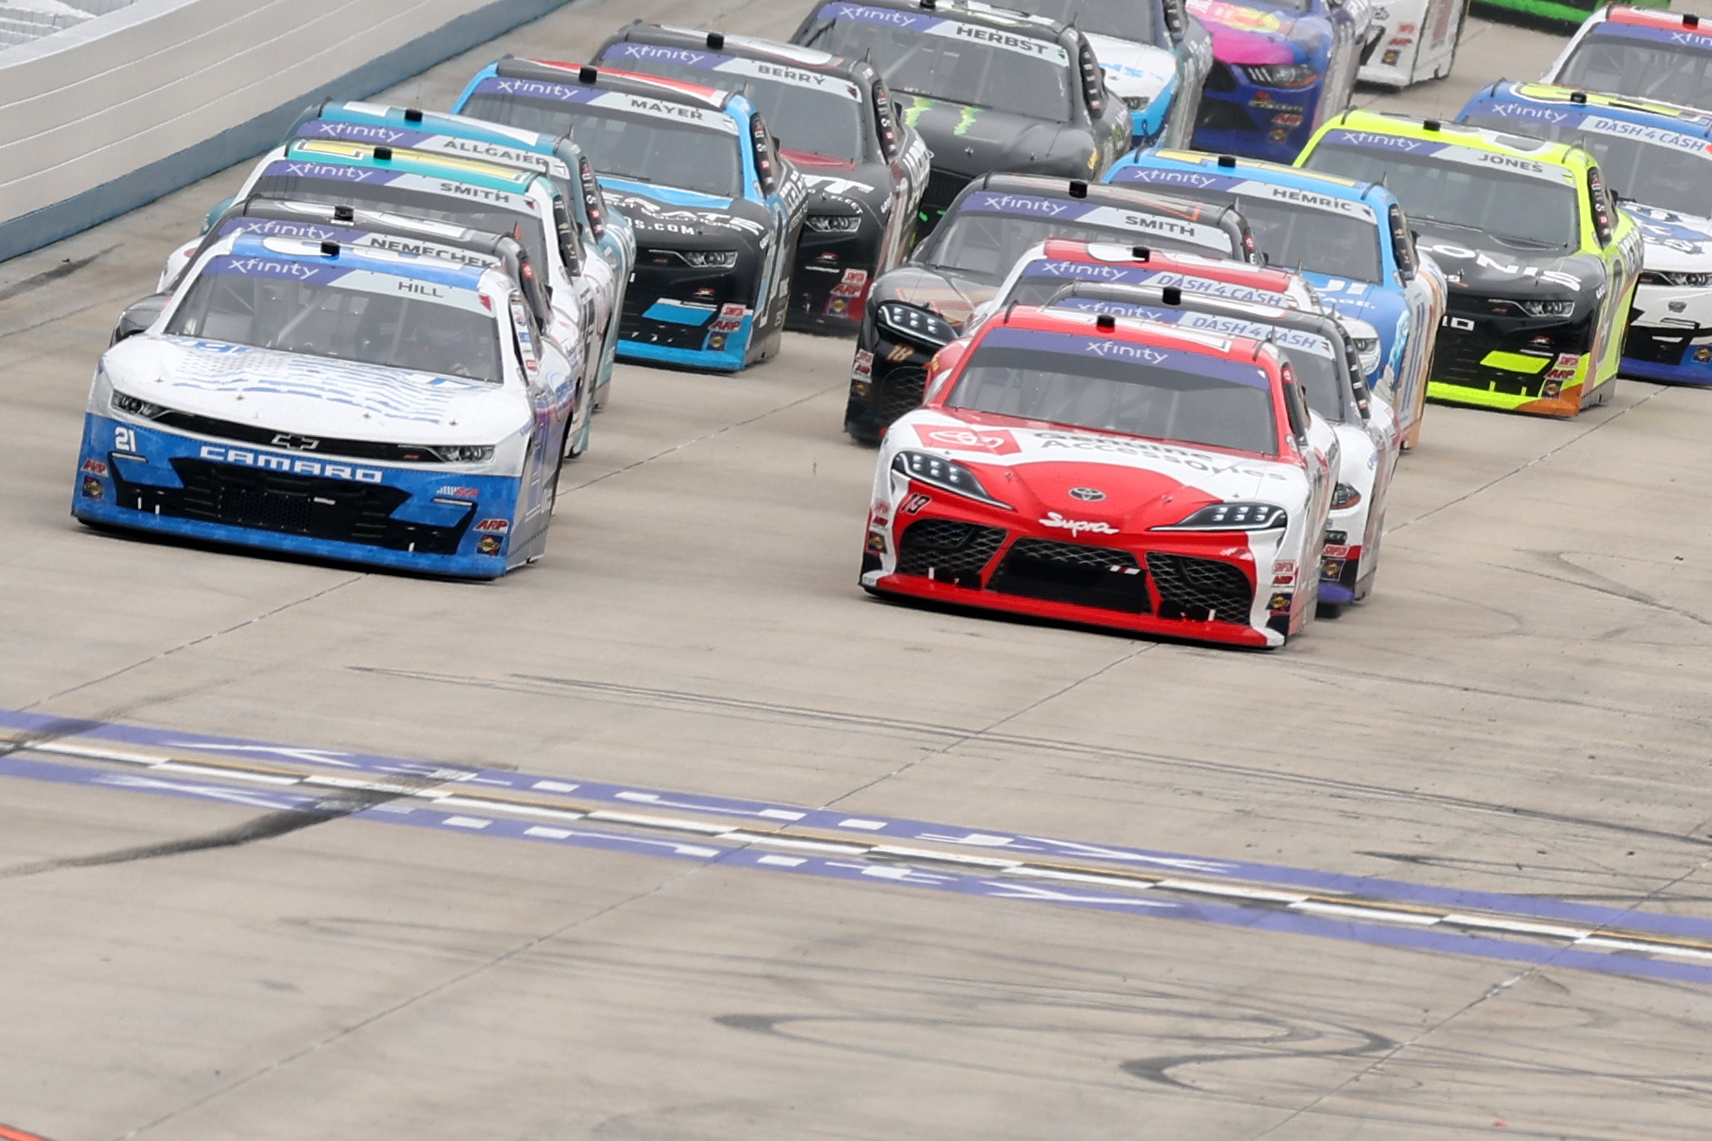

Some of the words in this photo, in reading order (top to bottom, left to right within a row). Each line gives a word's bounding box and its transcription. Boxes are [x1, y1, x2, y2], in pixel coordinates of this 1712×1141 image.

[837, 4, 919, 28] xfinity
[955, 24, 1049, 56] HERBST
[624, 44, 706, 67] xfinity
[757, 63, 826, 87] BERRY
[496, 79, 580, 102] xfinity
[630, 97, 705, 122] MAYER
[318, 123, 406, 143] xfinity
[442, 140, 549, 166] ALLGAIER
[1491, 102, 1569, 125] xfinity
[1594, 117, 1641, 138] DASH
[1643, 127, 1656, 139] 4
[1658, 131, 1706, 153] CASH
[1340, 131, 1423, 153] xfinity
[1478, 151, 1545, 175] JONES
[286, 162, 374, 184] xfinity
[439, 181, 511, 205] SMITH
[1133, 167, 1218, 190] xfinity
[1271, 186, 1353, 212] HEMRIC
[984, 193, 1069, 217] xfinity
[1123, 214, 1197, 238] SMITH
[369, 236, 498, 269] NEMECHEK
[228, 257, 321, 281] xfinity
[398, 279, 444, 299] HILL
[1042, 260, 1130, 281] xfinity
[1155, 271, 1213, 294] DASH
[1212, 283, 1228, 297] 4
[1228, 287, 1283, 307] CASH
[711, 320, 741, 330] ARP
[1192, 316, 1250, 336] DASH
[1250, 325, 1262, 337] 4
[1263, 328, 1317, 349] CASH
[1086, 339, 1169, 365] xfinity
[1547, 369, 1575, 379] ARP
[114, 426, 138, 452] 21
[1033, 431, 1214, 462] Genuine
[199, 445, 384, 484] CAMARO
[1041, 439, 1288, 482] Accessories
[901, 492, 932, 515] 19
[1038, 511, 1120, 537] Supra
[475, 519, 509, 531] ARP
